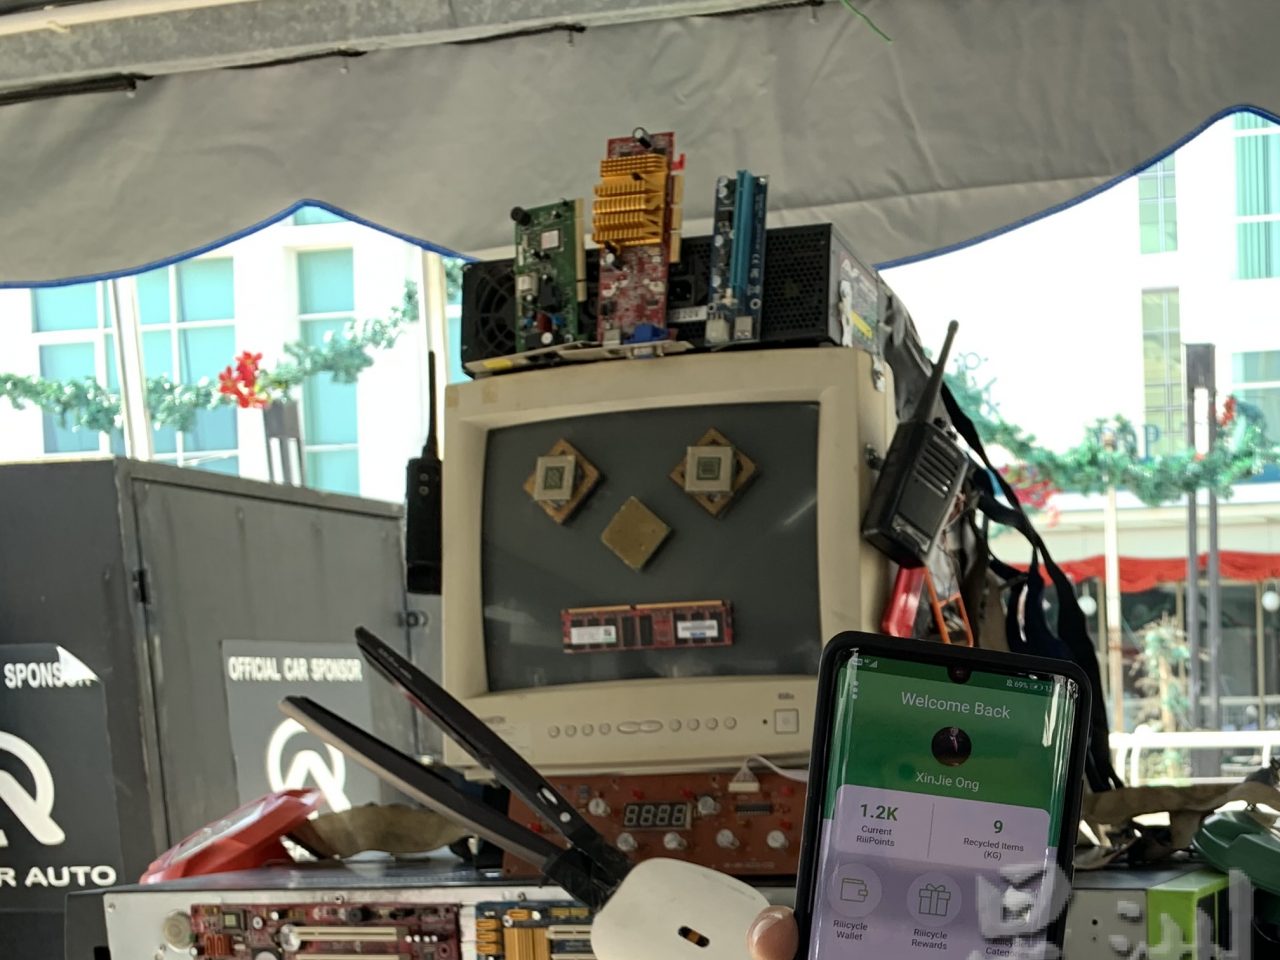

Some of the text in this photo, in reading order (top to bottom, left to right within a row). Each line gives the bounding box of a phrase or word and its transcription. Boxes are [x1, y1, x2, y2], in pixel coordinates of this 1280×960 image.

[3, 662, 92, 689] SPONS
[228, 656, 282, 682] OFFICIAL
[283, 657, 309, 682] CAR
[310, 658, 363, 682] SPONSOR
[901, 691, 1011, 720] Welcome Back
[915, 771, 980, 792] XinJie Ong
[860, 803, 899, 822] 1.2K
[861, 825, 892, 837] Current
[993, 819, 1004, 834] 9
[963, 837, 1024, 853] Recycled Items
[983, 851, 1002, 862] (KG)
[24, 865, 117, 887] AUTO
[836, 930, 863, 941] Wallet
[911, 939, 948, 950] Rewards
